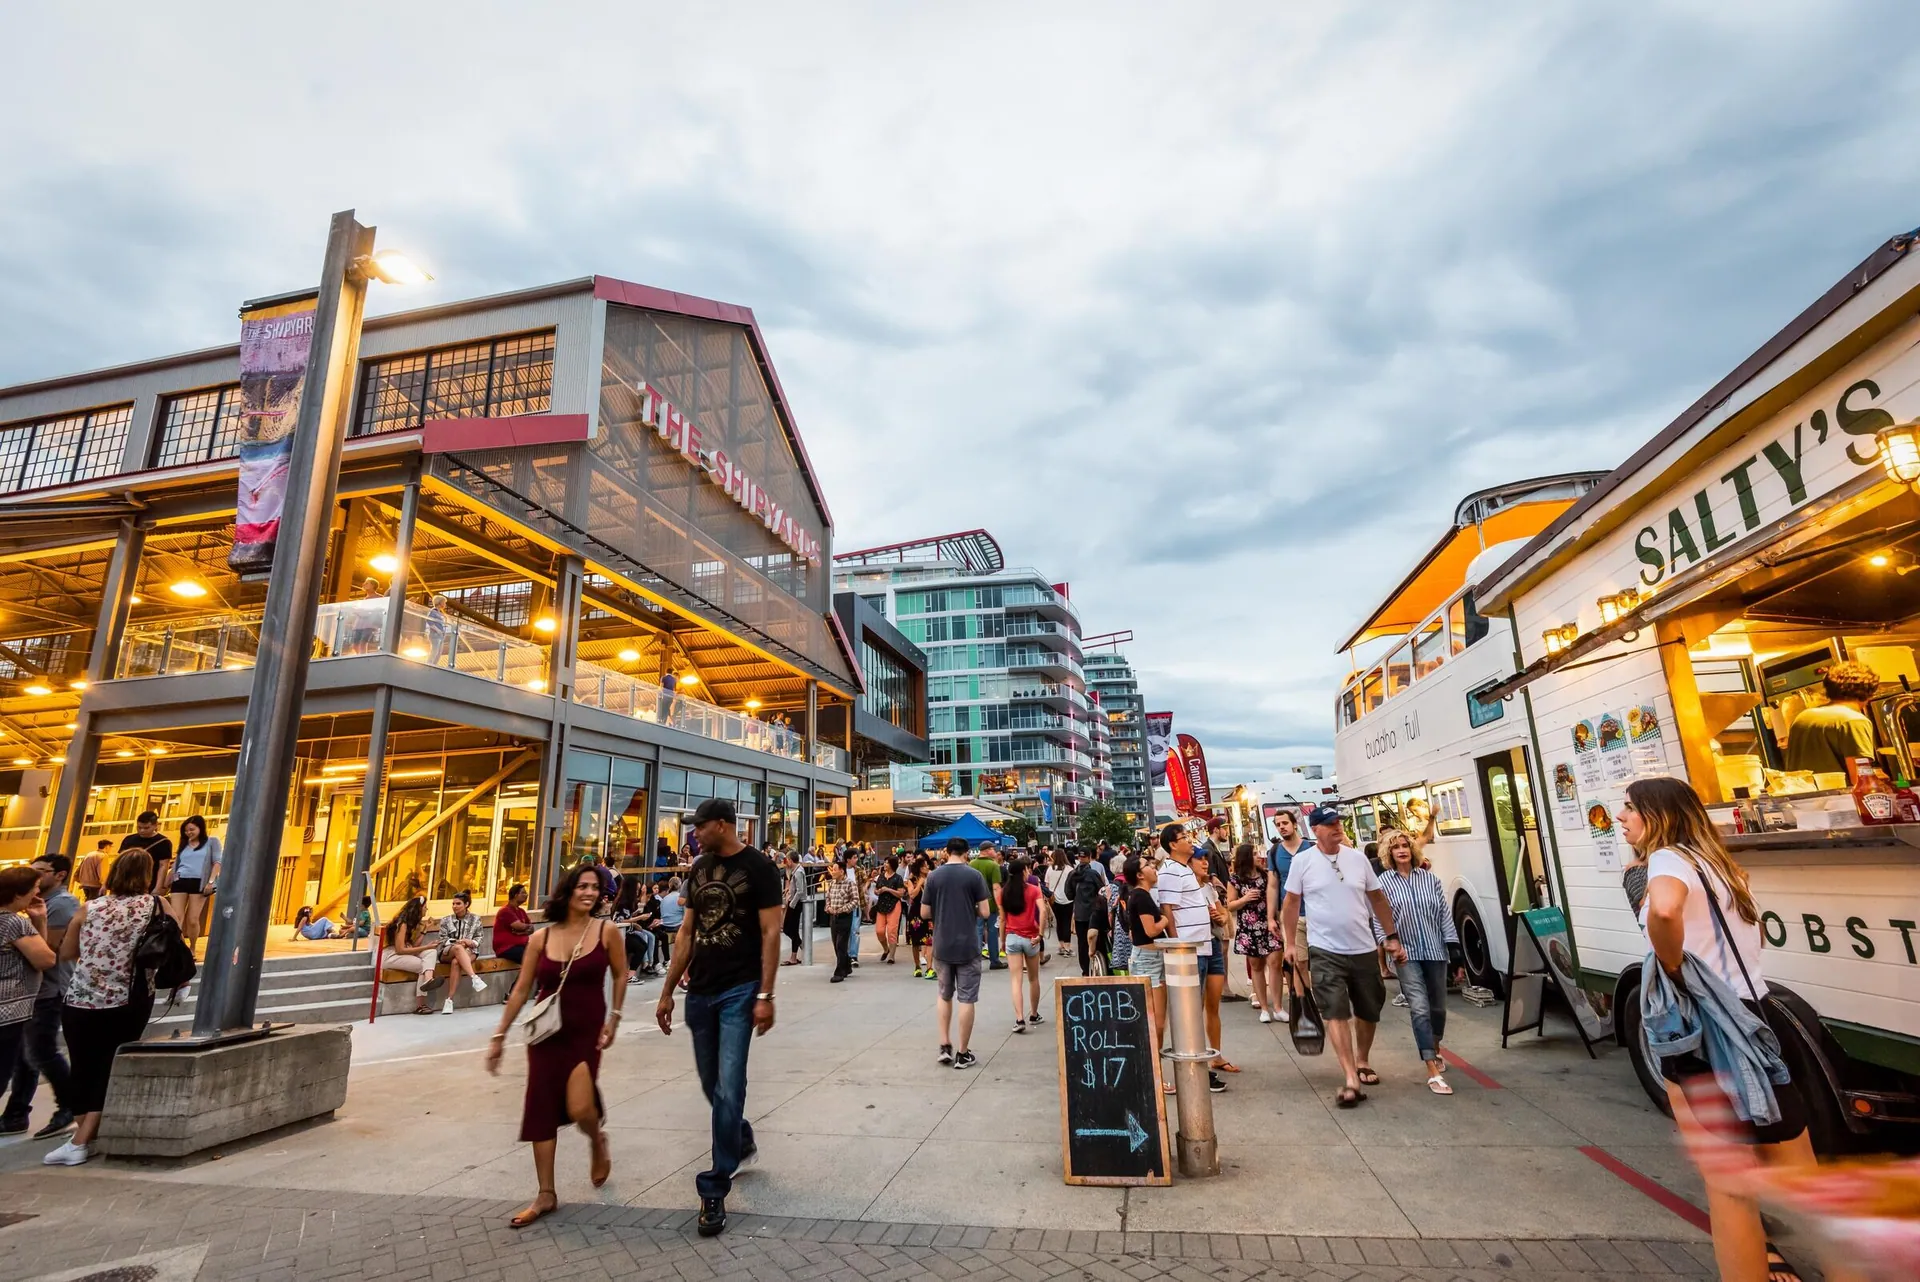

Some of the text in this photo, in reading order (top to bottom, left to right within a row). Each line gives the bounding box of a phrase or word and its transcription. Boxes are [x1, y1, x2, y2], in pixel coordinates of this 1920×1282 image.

[247, 327, 262, 340] THE
[637, 381, 823, 568] THE SHIPYARDS
[1634, 378, 1896, 587] SALTY'S
[1405, 709, 1421, 741] full
[1188, 758, 1206, 794] Cannoli
[1066, 990, 1140, 1022] CRAB
[1071, 1025, 1135, 1053] ROLL
[1081, 1057, 1127, 1089] $17
